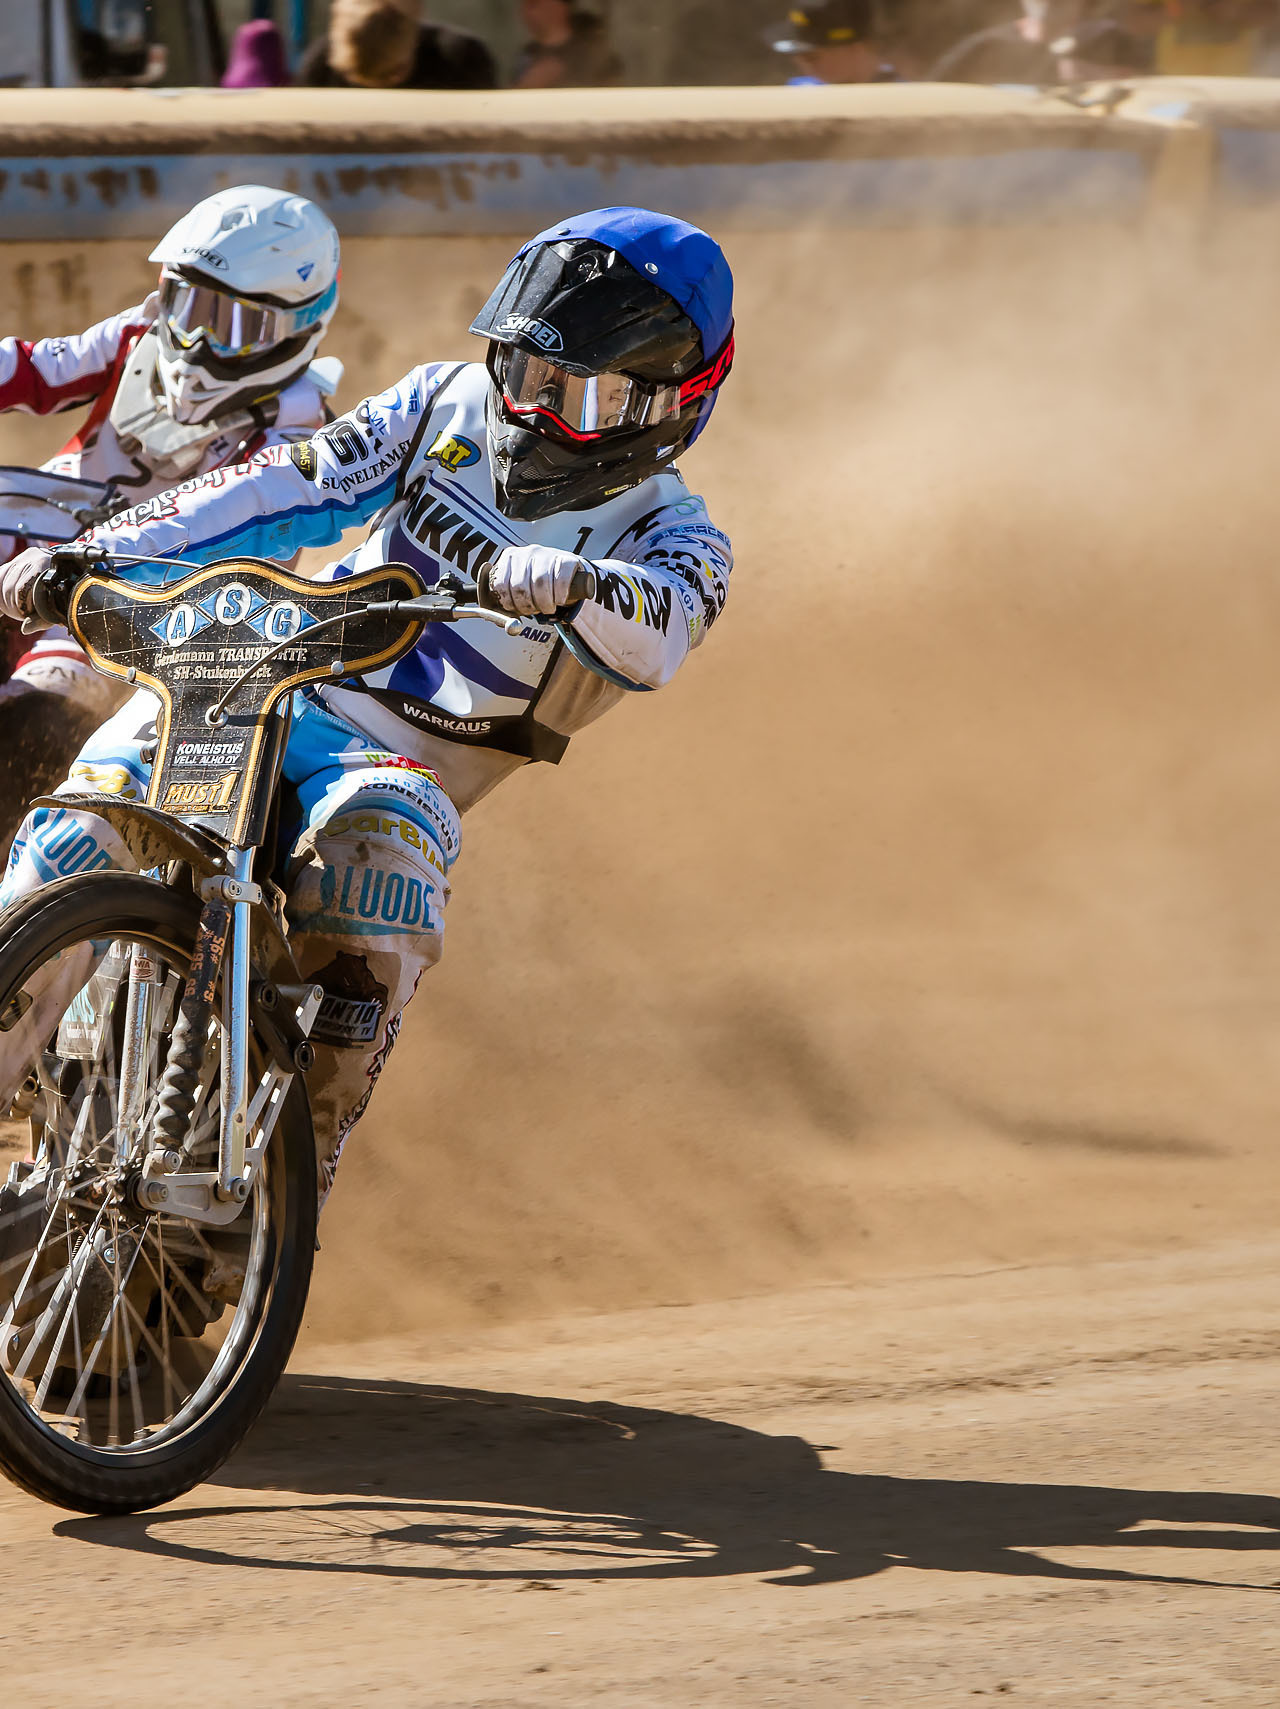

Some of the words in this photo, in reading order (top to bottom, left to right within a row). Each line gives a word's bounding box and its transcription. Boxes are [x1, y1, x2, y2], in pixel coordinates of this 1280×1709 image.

[501, 316, 558, 348] SHOEI
[403, 702, 491, 732] WARKAUS
[176, 740, 245, 755] KONEISTUS
